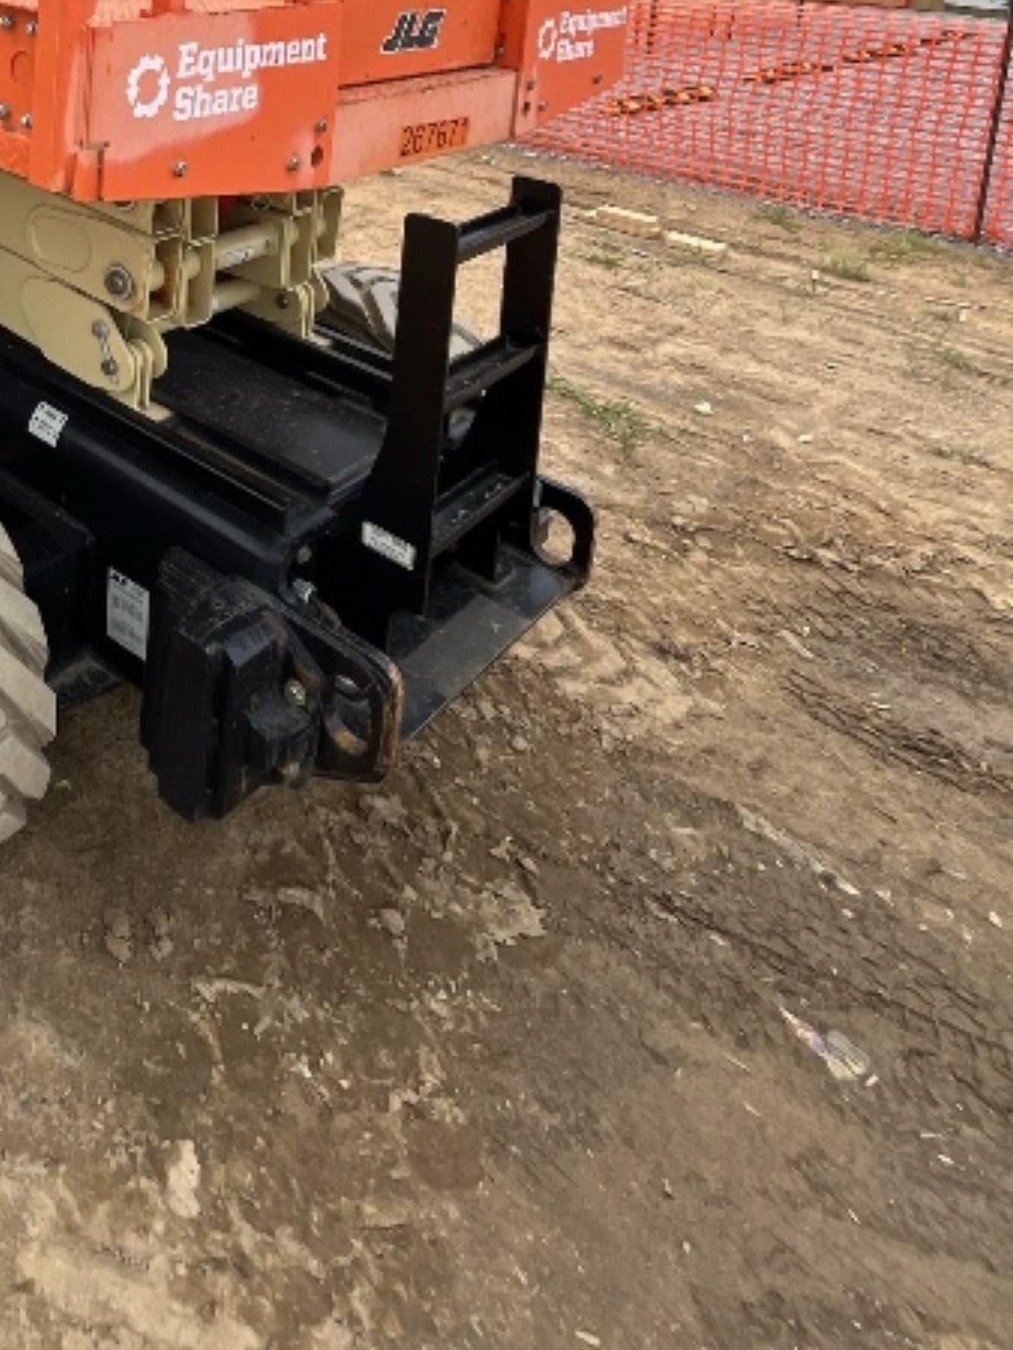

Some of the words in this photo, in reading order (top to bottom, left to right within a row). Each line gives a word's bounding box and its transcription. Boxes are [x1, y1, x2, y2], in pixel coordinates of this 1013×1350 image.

[380, 8, 447, 55] JLG
[559, 5, 627, 38] Equipment
[176, 32, 328, 82] Equipment
[556, 38, 594, 64] Share
[172, 82, 258, 121] Share
